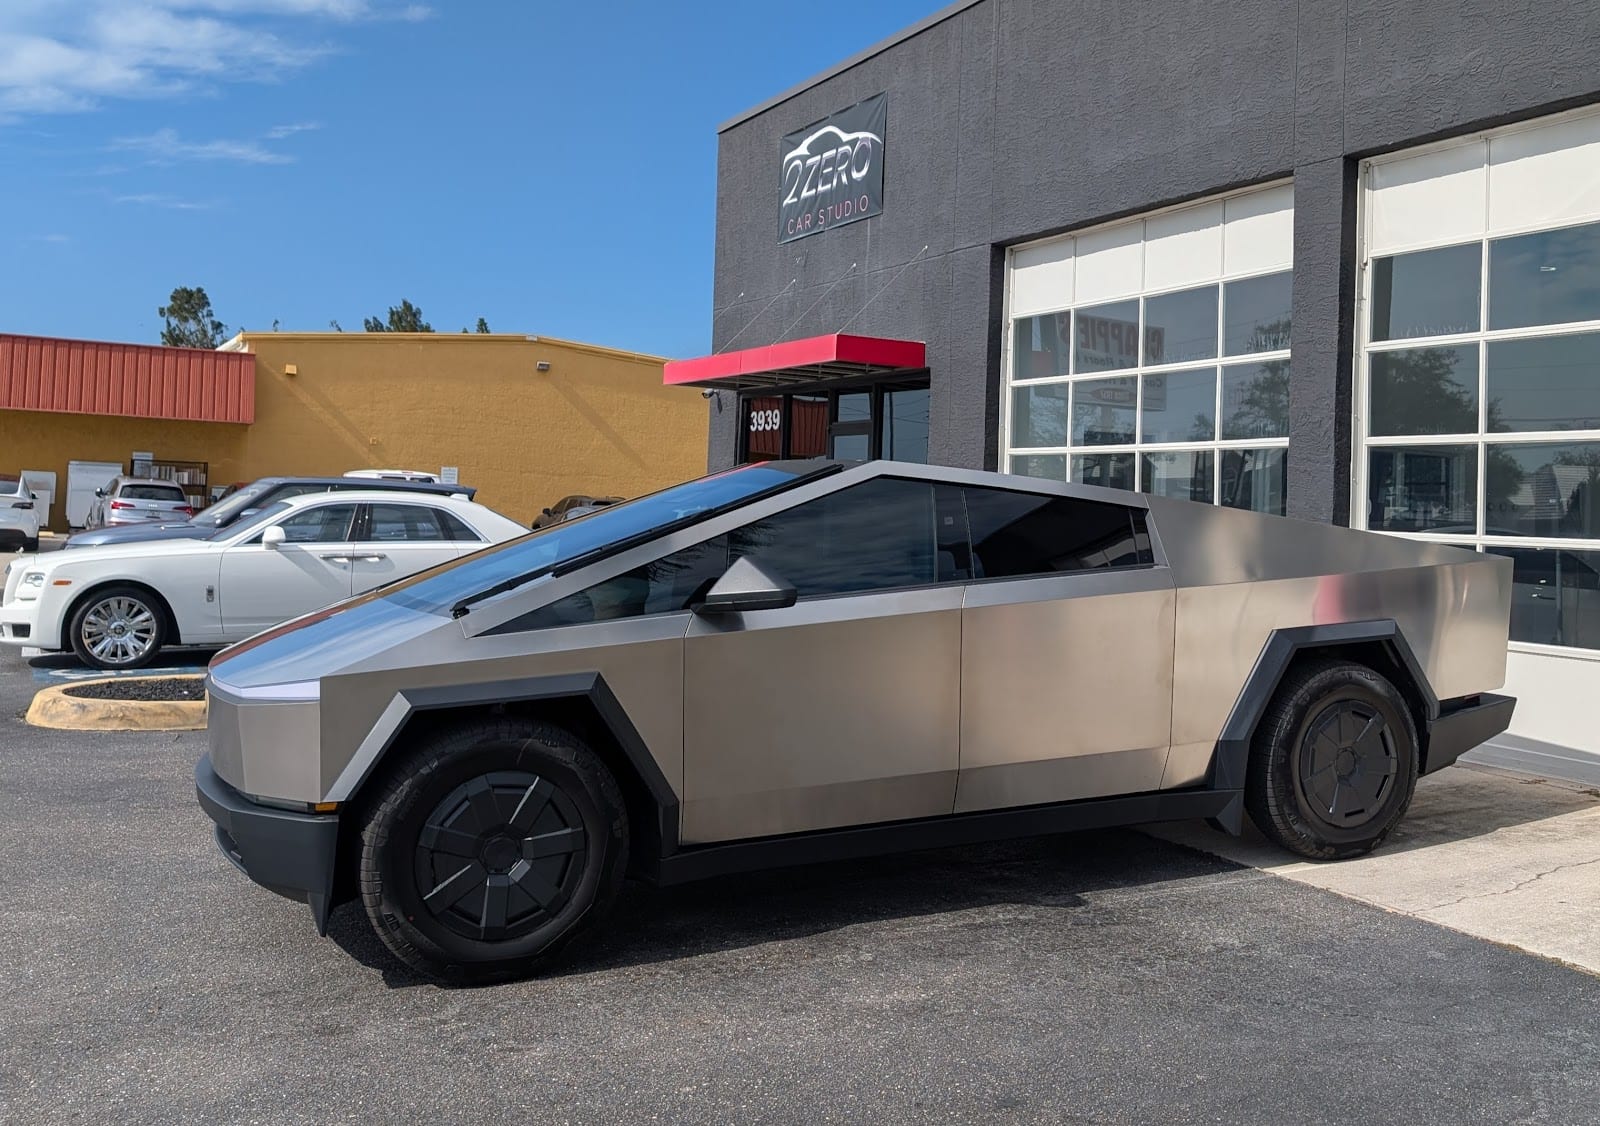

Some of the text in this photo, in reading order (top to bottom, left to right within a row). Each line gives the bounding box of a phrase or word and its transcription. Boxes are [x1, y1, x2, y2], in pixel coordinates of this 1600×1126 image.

[787, 195, 869, 235] CAR STUDIO
[750, 409, 780, 431] 3939
